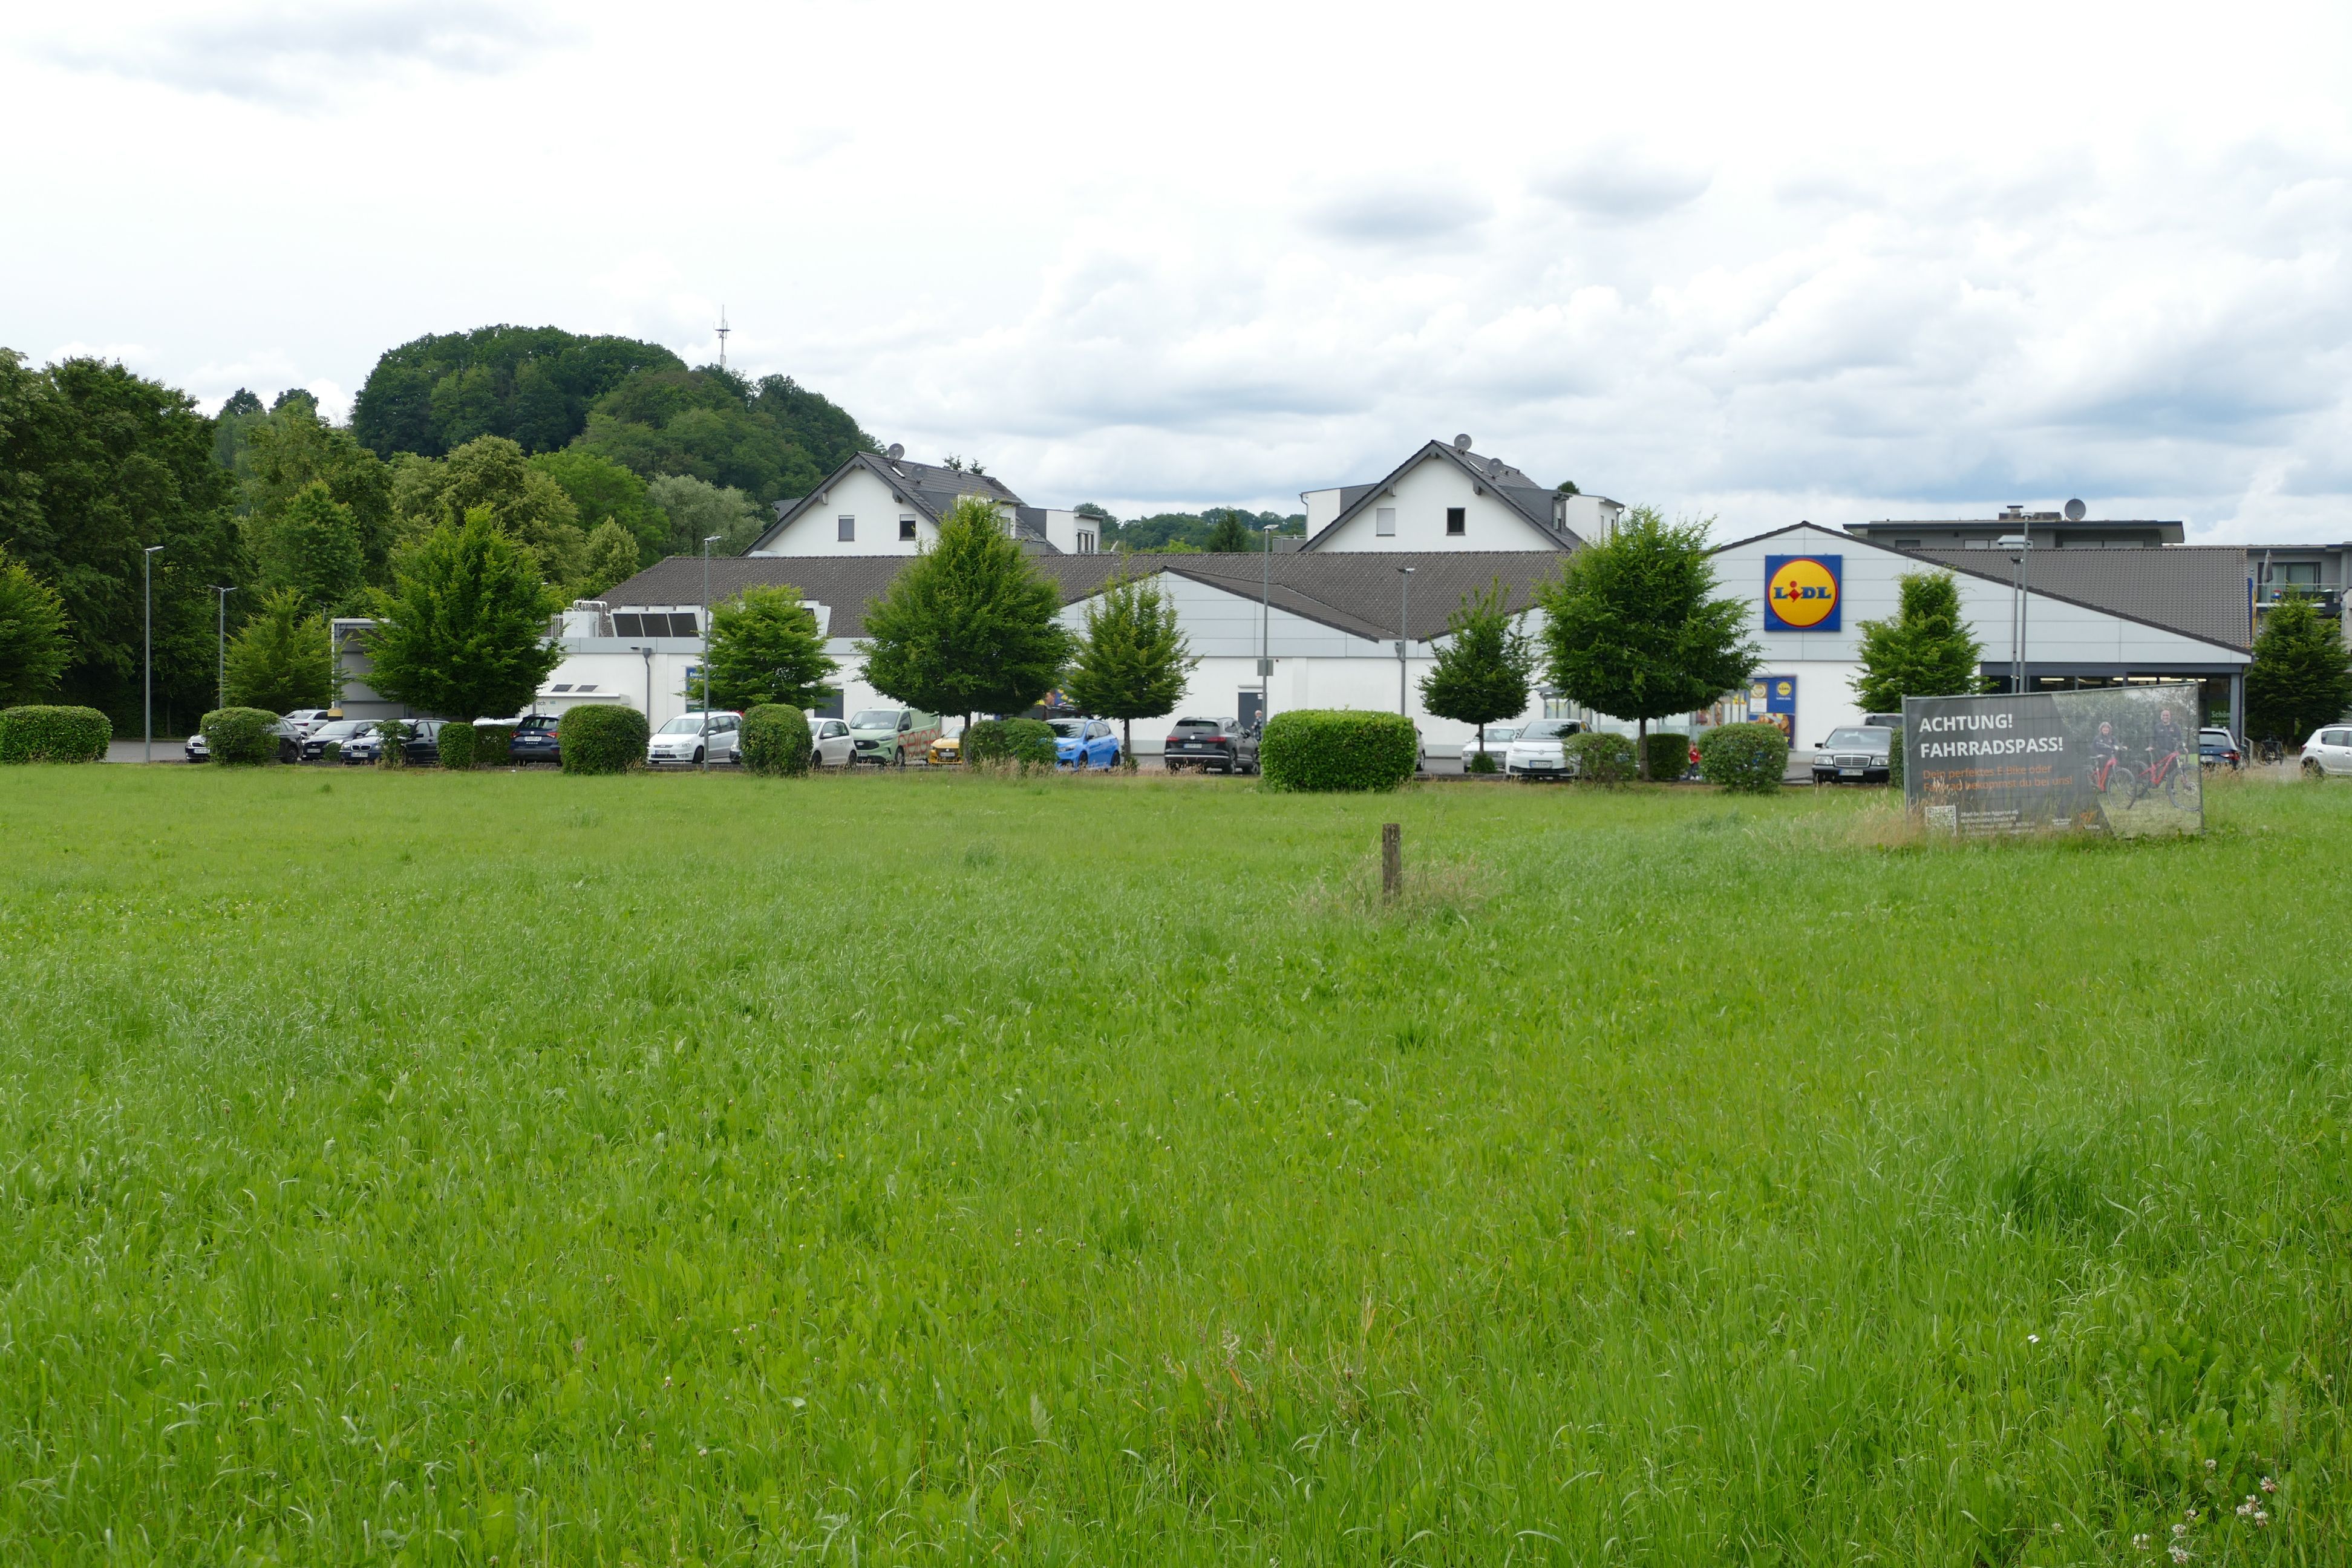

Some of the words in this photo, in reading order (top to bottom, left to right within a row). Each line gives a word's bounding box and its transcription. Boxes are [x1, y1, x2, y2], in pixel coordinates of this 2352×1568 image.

[1919, 714, 2013, 733] ACHTUNG!
[1920, 737, 2063, 758] FAHRRADSPASS!
[1922, 769, 1945, 779] Dein
[1949, 767, 1994, 780] perfektes
[2029, 764, 2053, 774] oder
[1965, 778, 2017, 791] bekommst
[2019, 778, 2031, 786] du
[2034, 777, 2050, 786] bei
[2052, 775, 2073, 785] uns!
